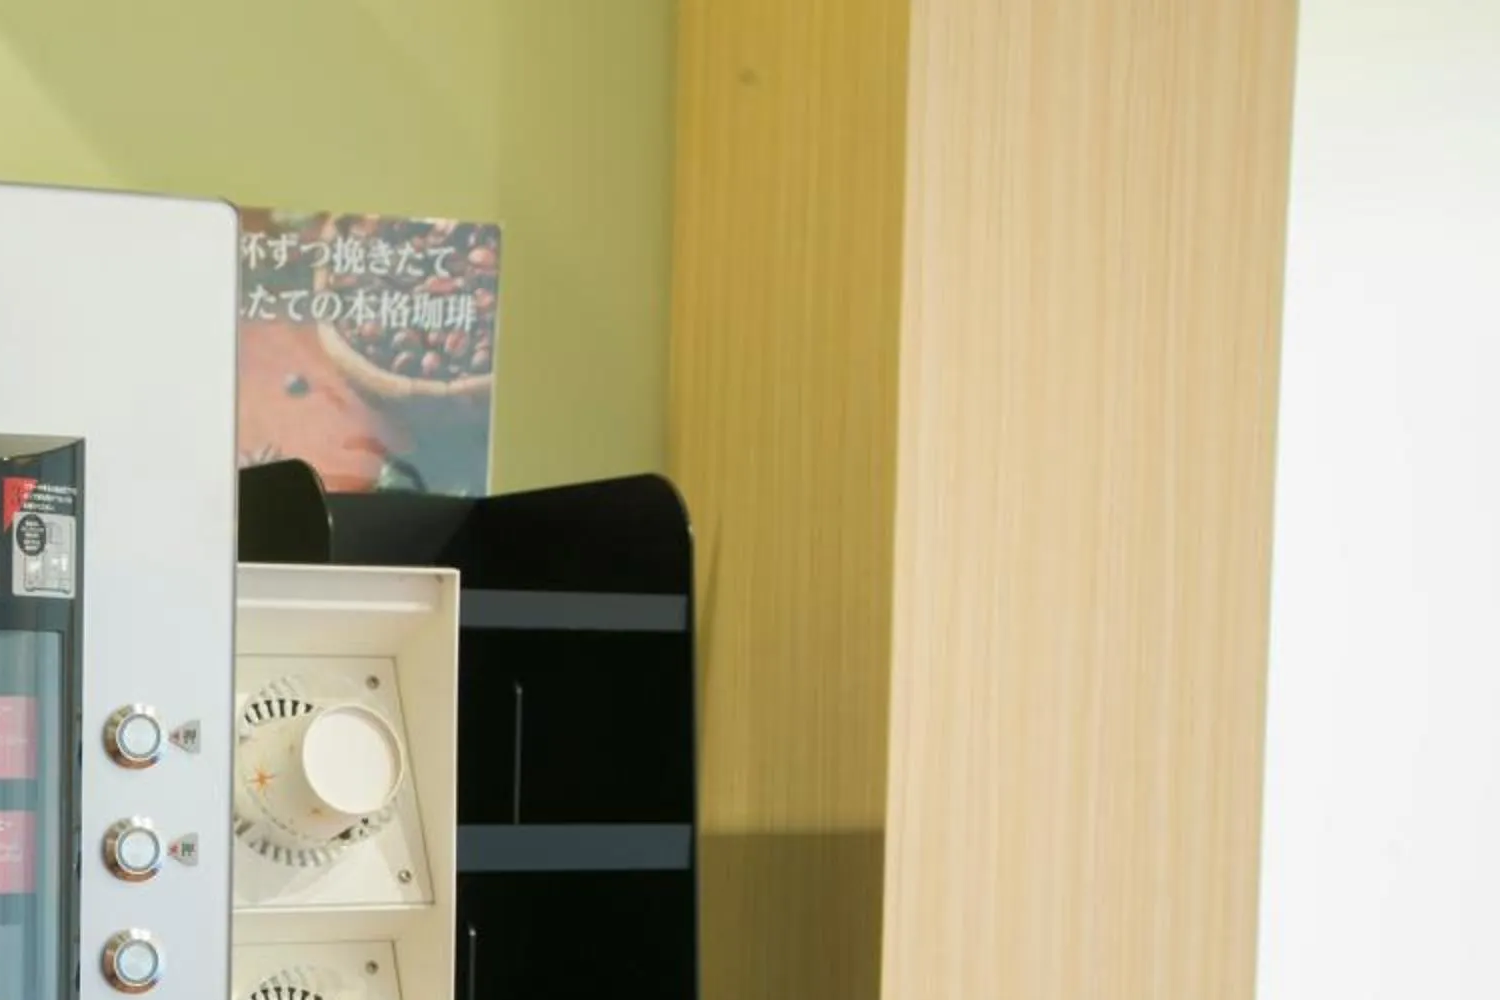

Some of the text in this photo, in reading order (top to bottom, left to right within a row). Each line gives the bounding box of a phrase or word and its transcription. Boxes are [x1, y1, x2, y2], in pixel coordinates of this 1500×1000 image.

[240, 285, 477, 331] たての本格珈琲
